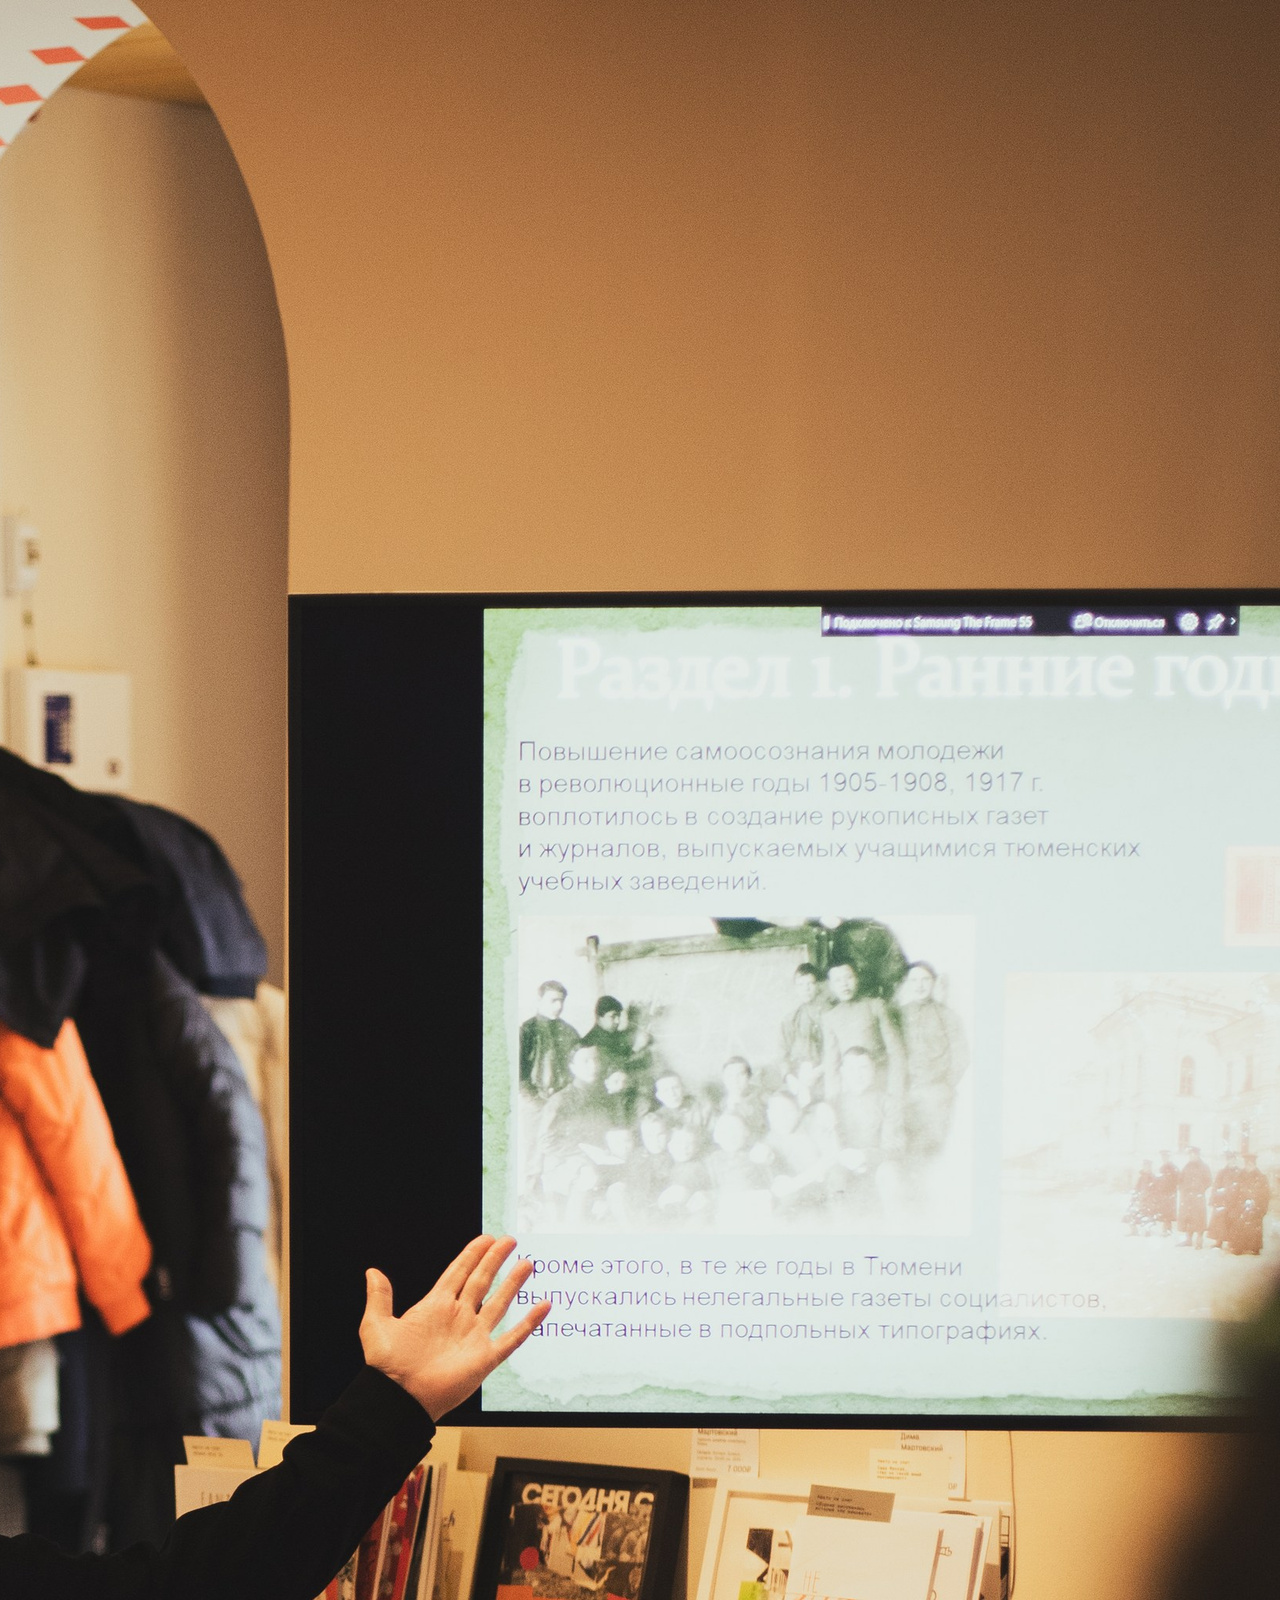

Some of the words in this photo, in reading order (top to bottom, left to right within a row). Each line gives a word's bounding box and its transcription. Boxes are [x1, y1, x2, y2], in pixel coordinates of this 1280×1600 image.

[833, 616, 903, 631] Подключено
[914, 616, 961, 632] Samsung
[963, 616, 983, 629] The
[984, 616, 1017, 629] Frame
[1094, 616, 1166, 630] Отключиться
[557, 638, 791, 711] Раздел
[875, 636, 1135, 698] Ранние
[1153, 652, 1280, 711] год
[518, 738, 669, 762] Повышение
[674, 743, 870, 761] самоосознания
[876, 743, 1005, 765] молодежи
[518, 775, 532, 793] в
[538, 775, 745, 799] революционные
[751, 775, 810, 796] годы
[820, 770, 955, 795] 1905-1908,
[966, 769, 1023, 792] 1917
[1031, 775, 1044, 792] г.
[517, 808, 679, 826] воплотилось
[684, 808, 699, 826] в
[706, 808, 824, 829] создание
[830, 808, 979, 831] рукописных
[986, 808, 1050, 826] газет
[517, 841, 532, 859] и
[538, 841, 667, 864] журналов,
[676, 841, 848, 864] выпускаемых
[854, 840, 997, 864] учащимися
[1003, 840, 1141, 858] тюменских
[517, 869, 624, 897] учебных
[629, 868, 767, 894] заведений.
[601, 1257, 671, 1278] этого,
[680, 1258, 693, 1275] в
[700, 1258, 728, 1276] те
[734, 1258, 768, 1276] же
[775, 1258, 833, 1279] годы
[842, 1259, 856, 1276] в
[863, 1253, 963, 1277] Тюмени
[516, 1288, 677, 1311] выпускались
[682, 1288, 845, 1308] нелегальные
[851, 1289, 932, 1308] газеты
[938, 1290, 1107, 1312] социалистов,
[530, 1319, 693, 1339] апечатанные
[699, 1321, 713, 1339] в
[719, 1321, 871, 1343] подпольных
[877, 1319, 1048, 1346] типографиях.
[900, 1432, 920, 1441] Дима
[900, 1444, 944, 1452] Мартовский
[522, 1482, 631, 1514] СЕГОДНЯ
[802, 1569, 821, 1594] НЕ
